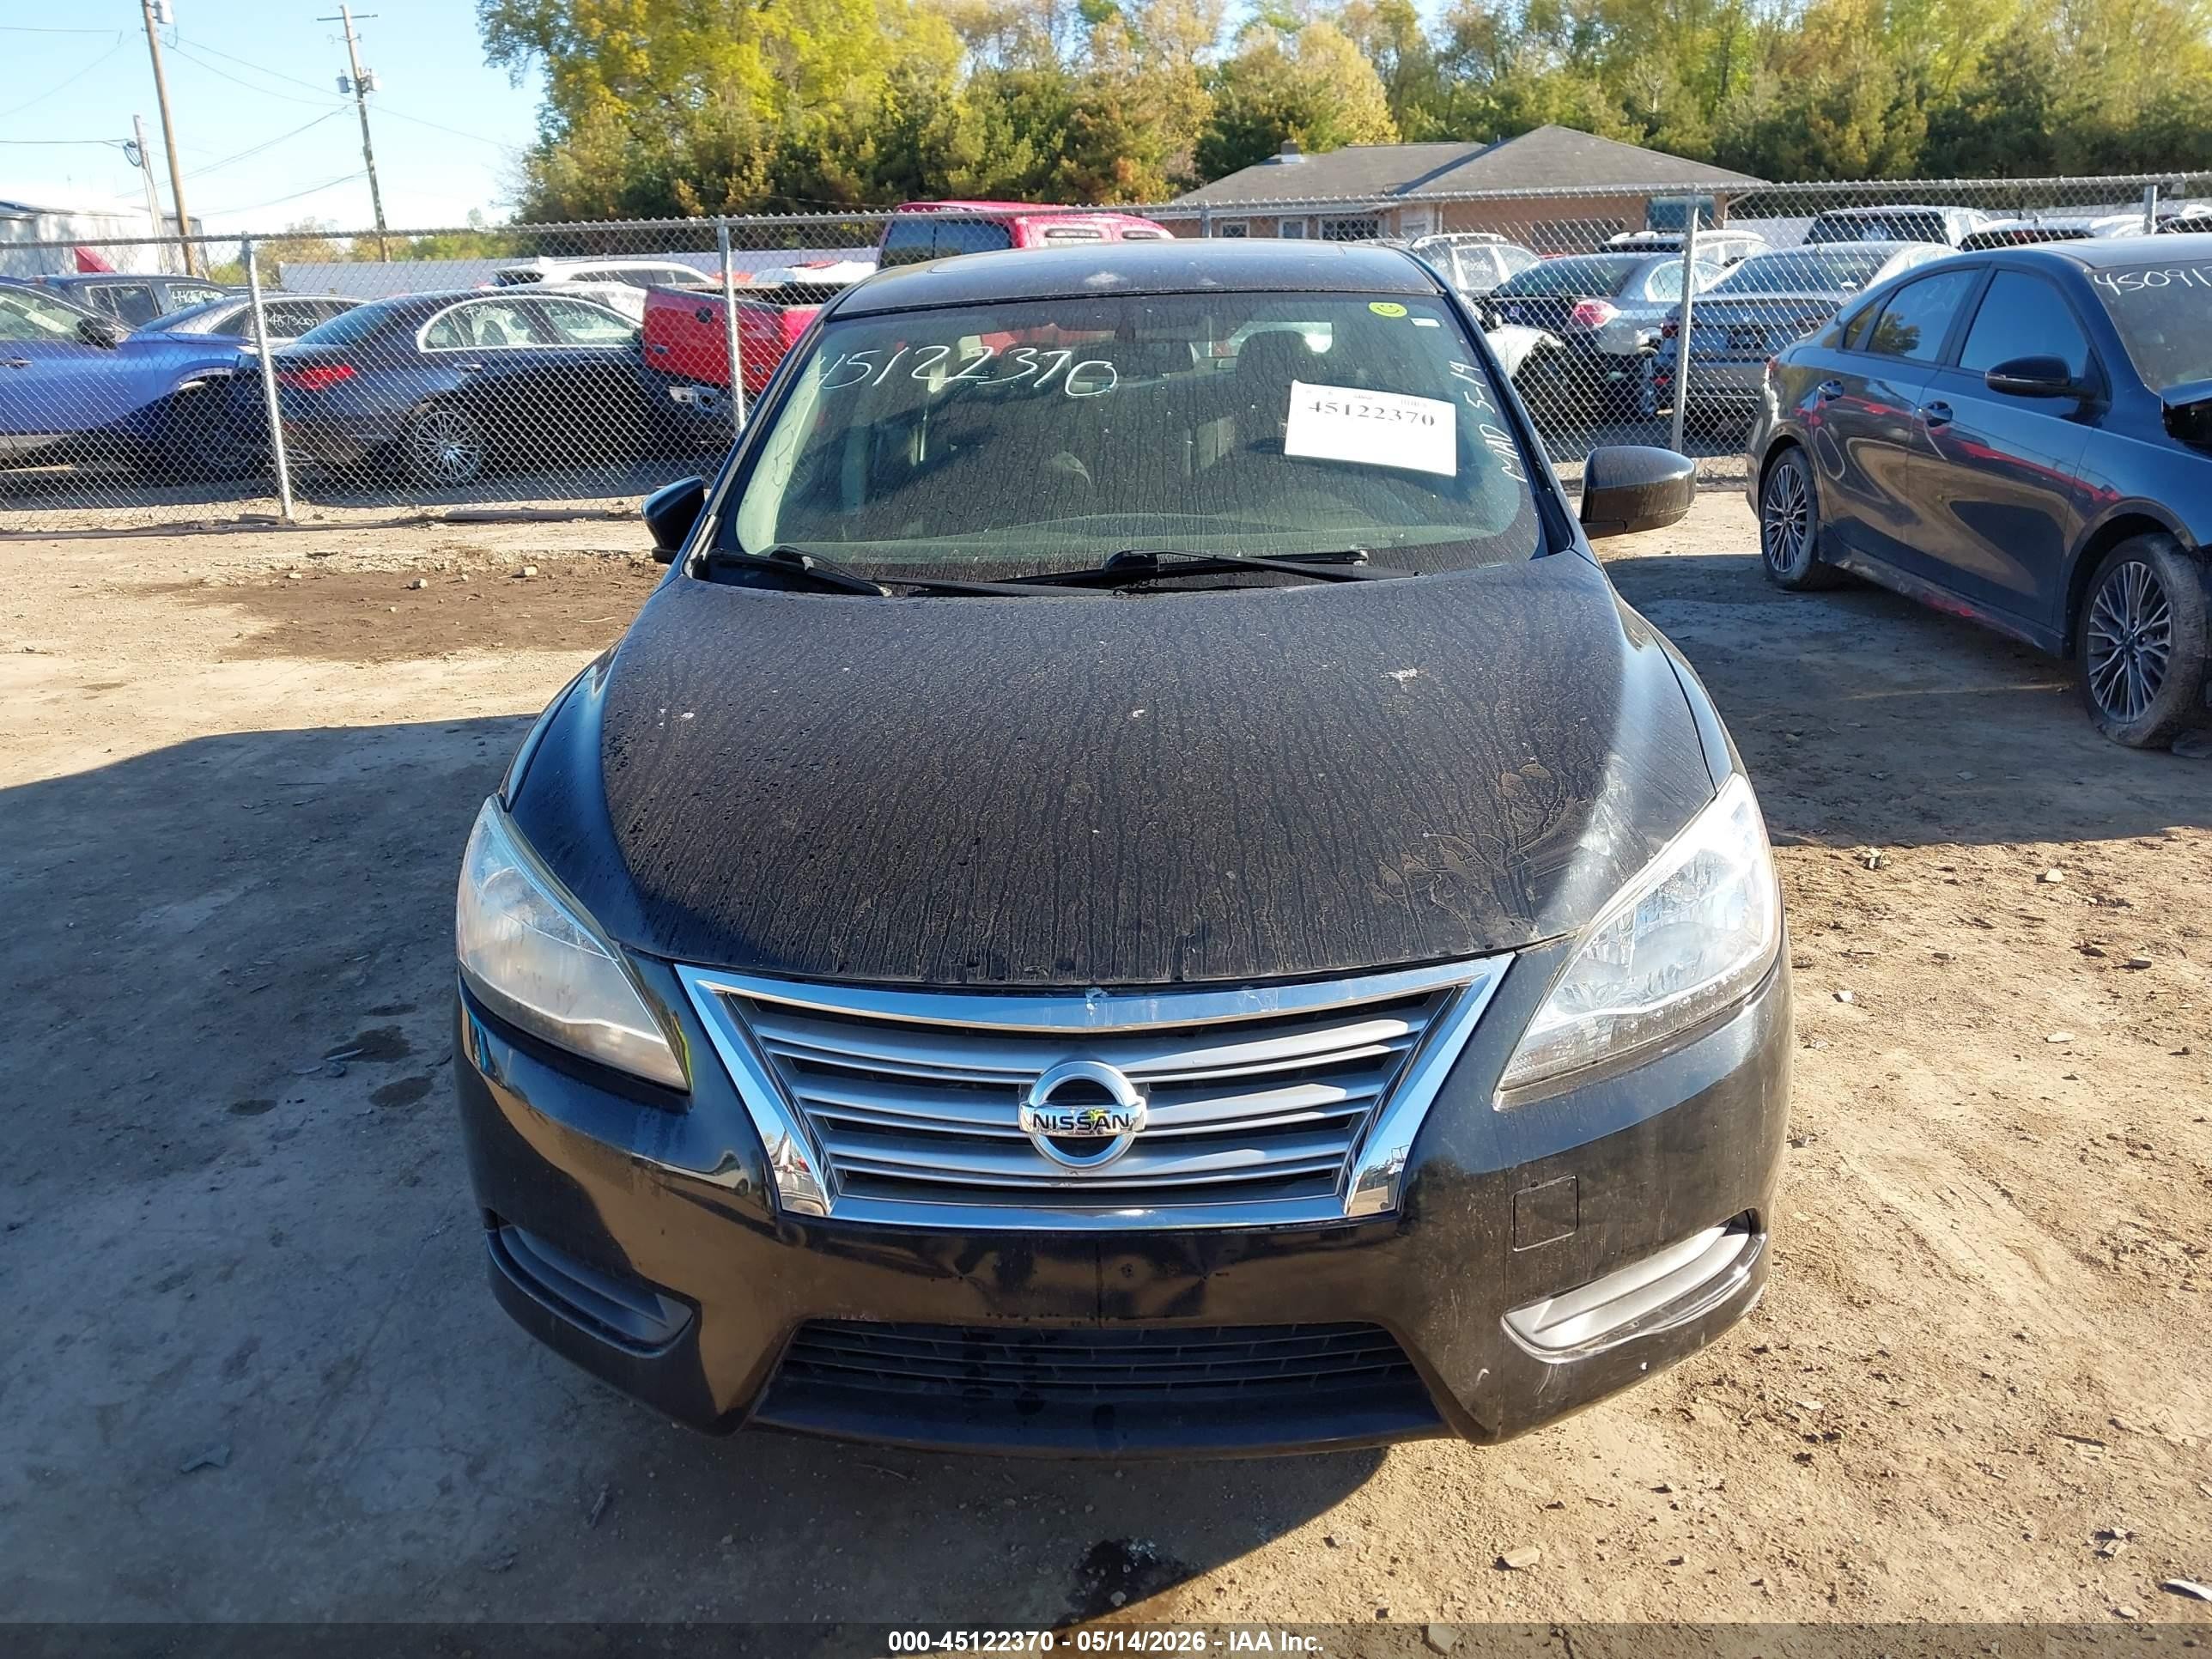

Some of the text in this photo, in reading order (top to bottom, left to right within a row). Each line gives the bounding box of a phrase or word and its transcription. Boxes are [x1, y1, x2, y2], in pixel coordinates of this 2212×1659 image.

[817, 344, 1118, 398] 45122370
[1308, 400, 1436, 427] 45122370
[1032, 1112, 1131, 1131] NISSAN
